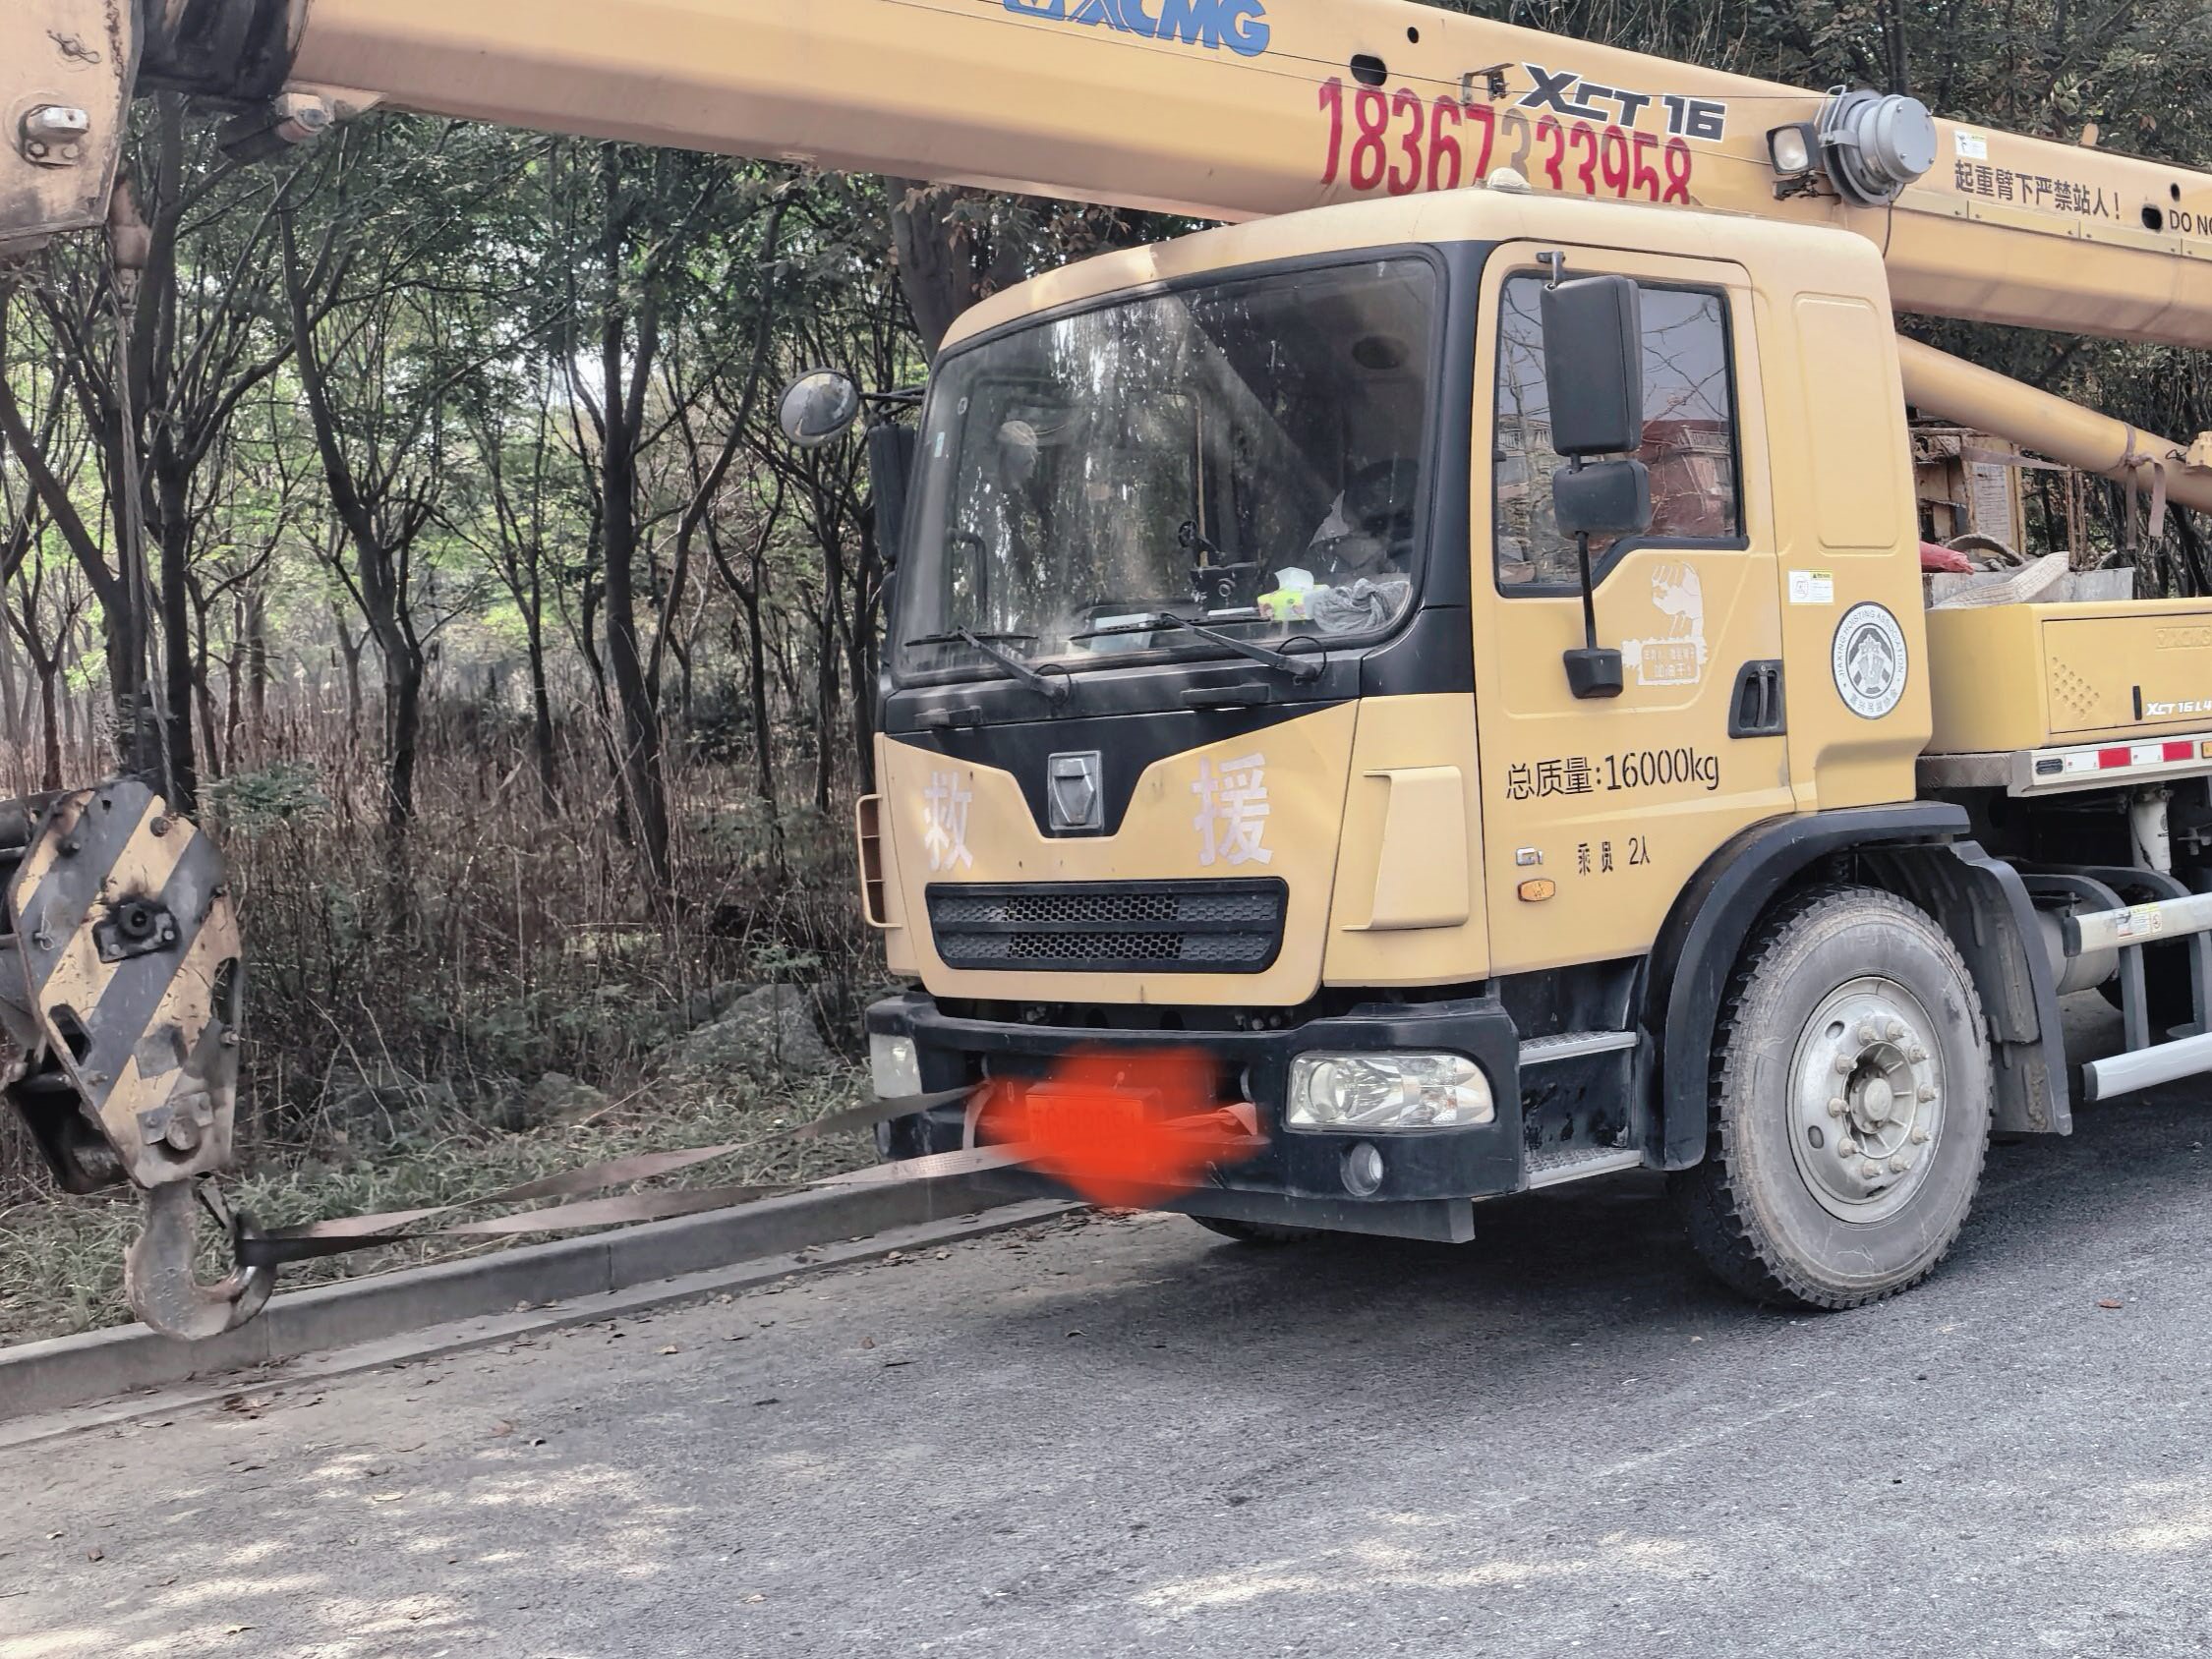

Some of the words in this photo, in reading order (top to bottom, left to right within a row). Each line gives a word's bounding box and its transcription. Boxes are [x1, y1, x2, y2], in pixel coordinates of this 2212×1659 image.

[1520, 62, 1652, 129] XCT
[1662, 93, 1728, 143] 16
[2169, 208, 2192, 233] DO
[923, 771, 974, 873] 救
[1191, 753, 1274, 867] 援
